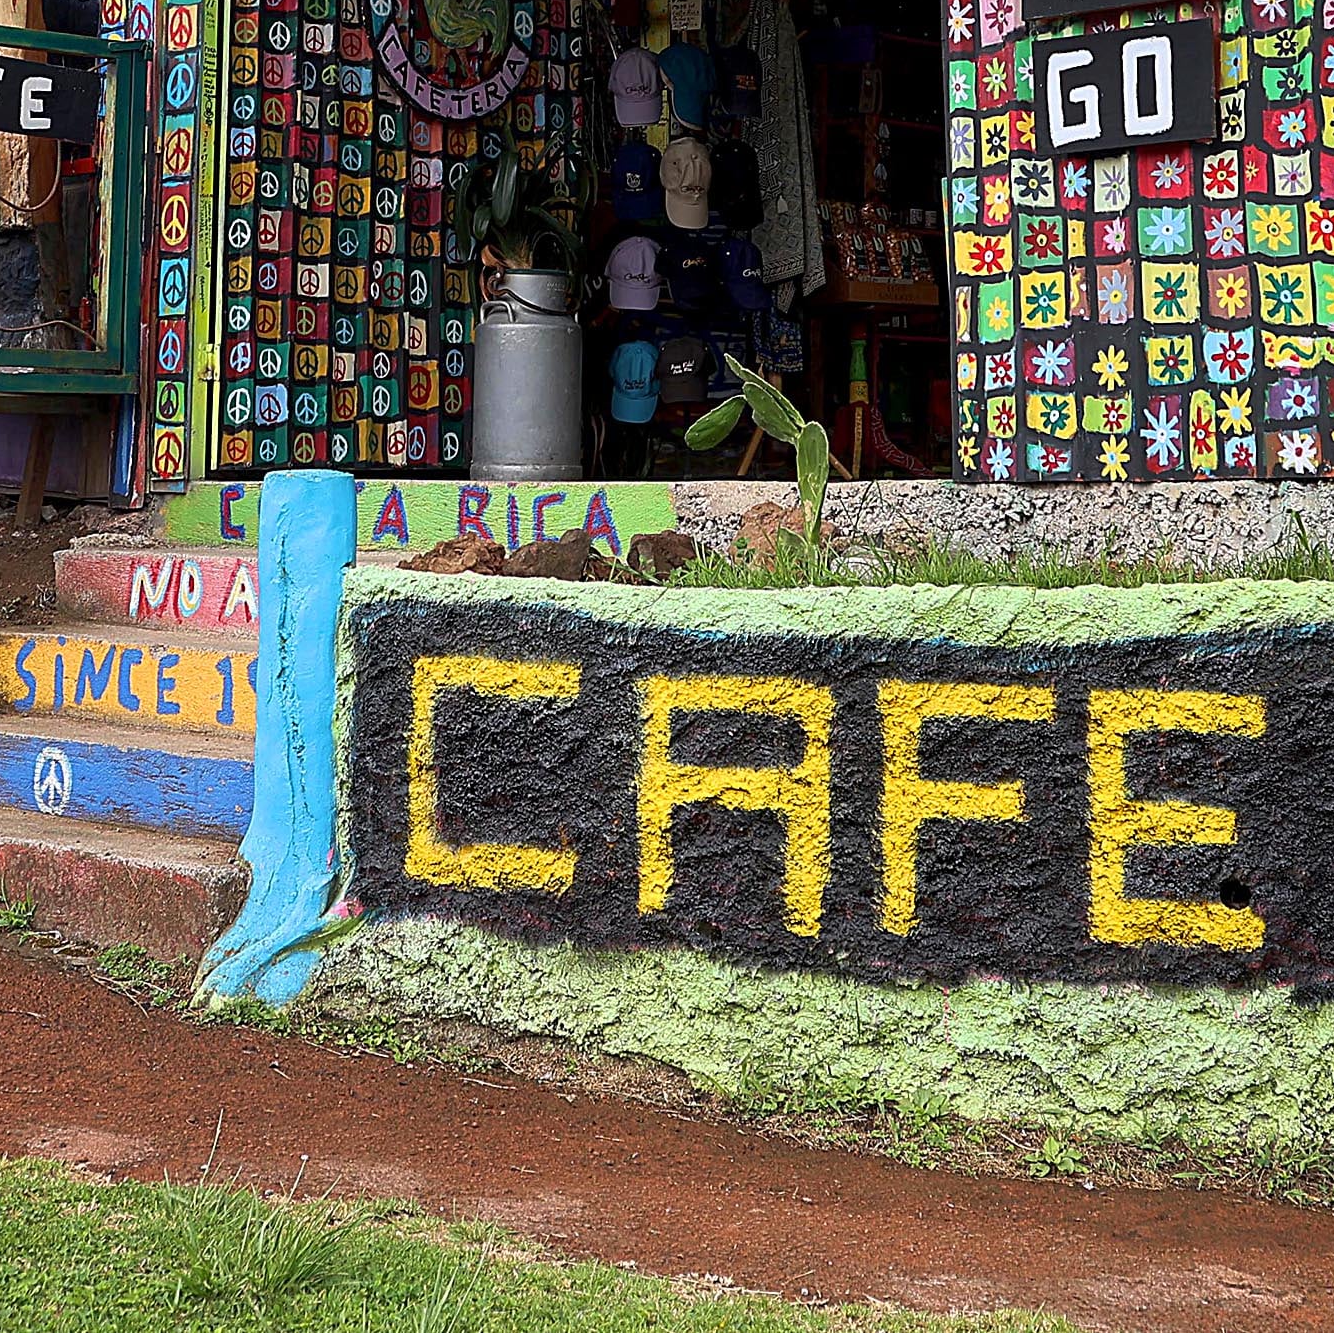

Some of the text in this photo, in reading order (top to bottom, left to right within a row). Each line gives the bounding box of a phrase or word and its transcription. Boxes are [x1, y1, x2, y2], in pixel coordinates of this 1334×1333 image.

[380, 34, 525, 115] CAFETERIA
[1046, 35, 1174, 148] GO
[129, 555, 204, 622] NO
[407, 655, 1269, 953] CAFE
